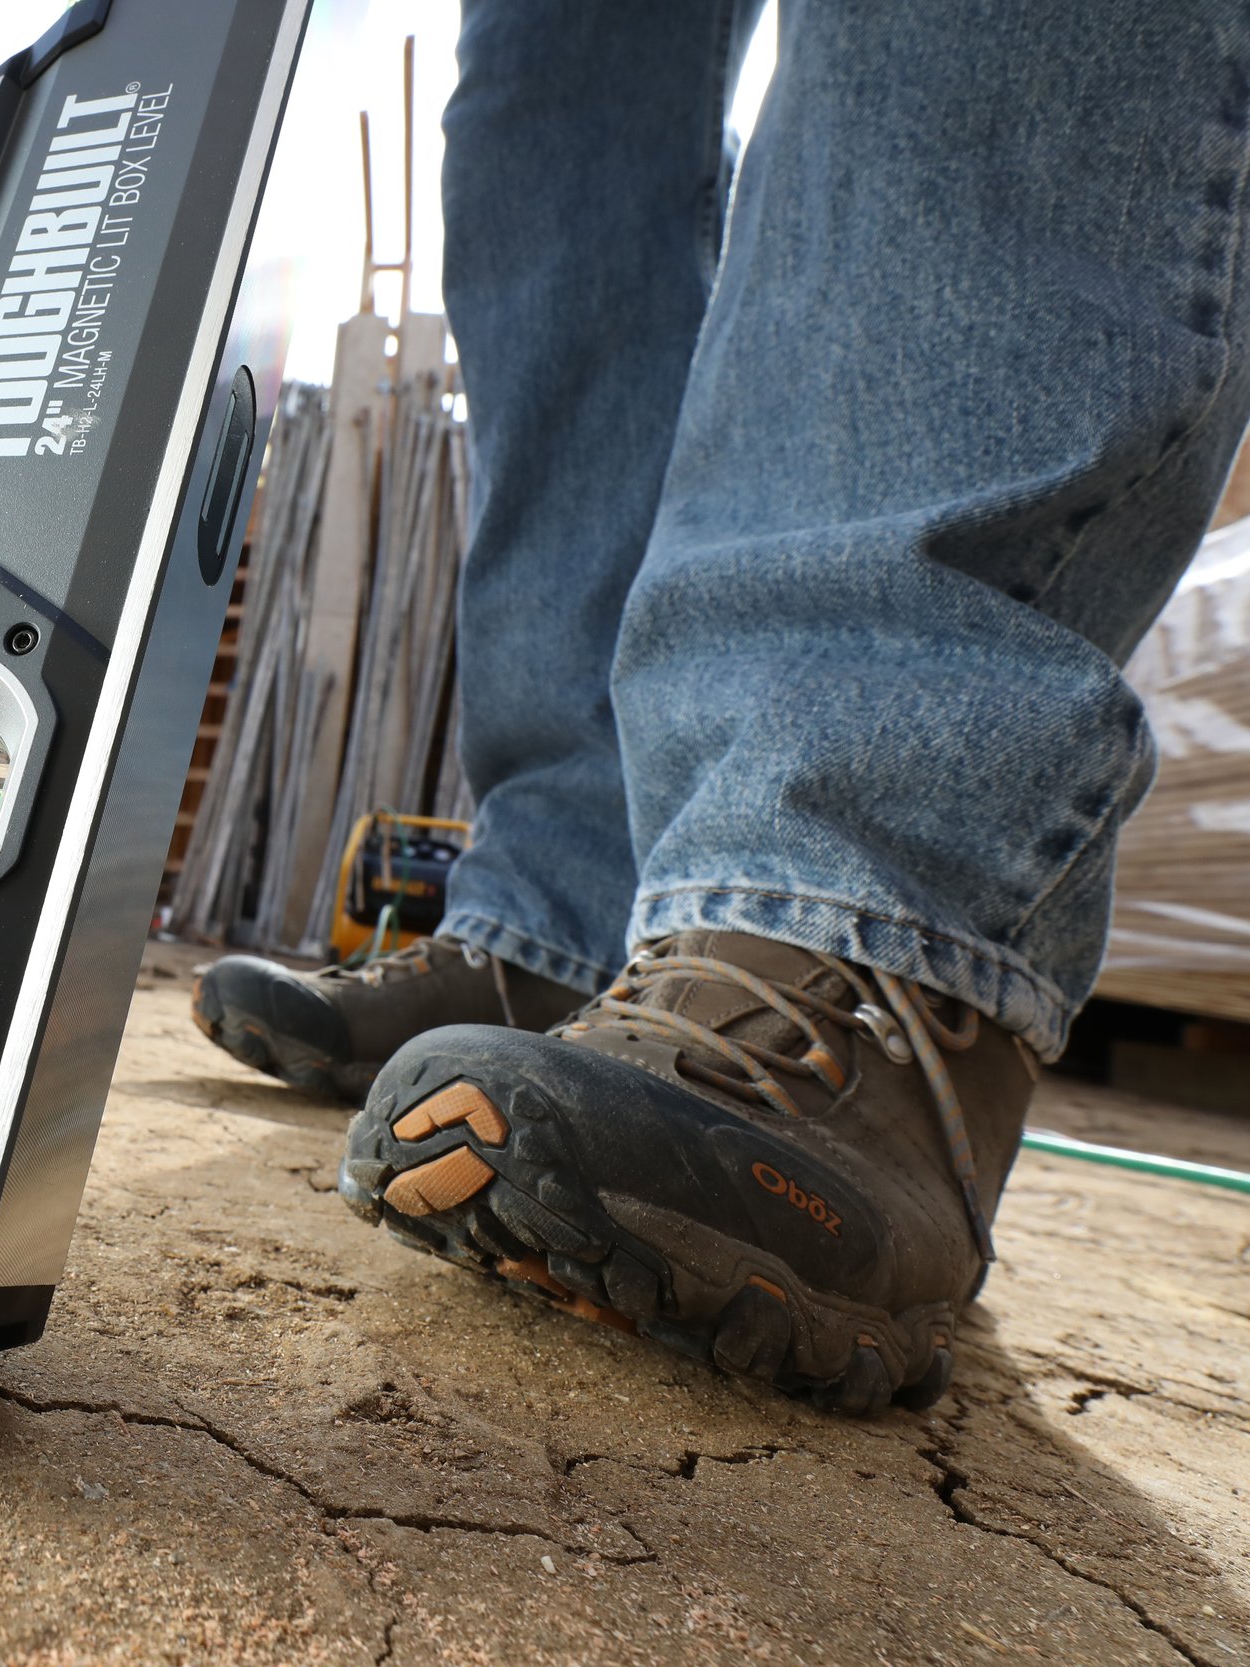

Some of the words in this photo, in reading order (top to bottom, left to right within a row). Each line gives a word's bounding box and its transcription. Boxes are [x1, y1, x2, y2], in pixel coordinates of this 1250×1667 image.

[125, 82, 174, 152] LEVEL
[108, 155, 152, 207] BOX
[96, 214, 134, 248] LIT
[53, 255, 121, 389] MAGNETIC
